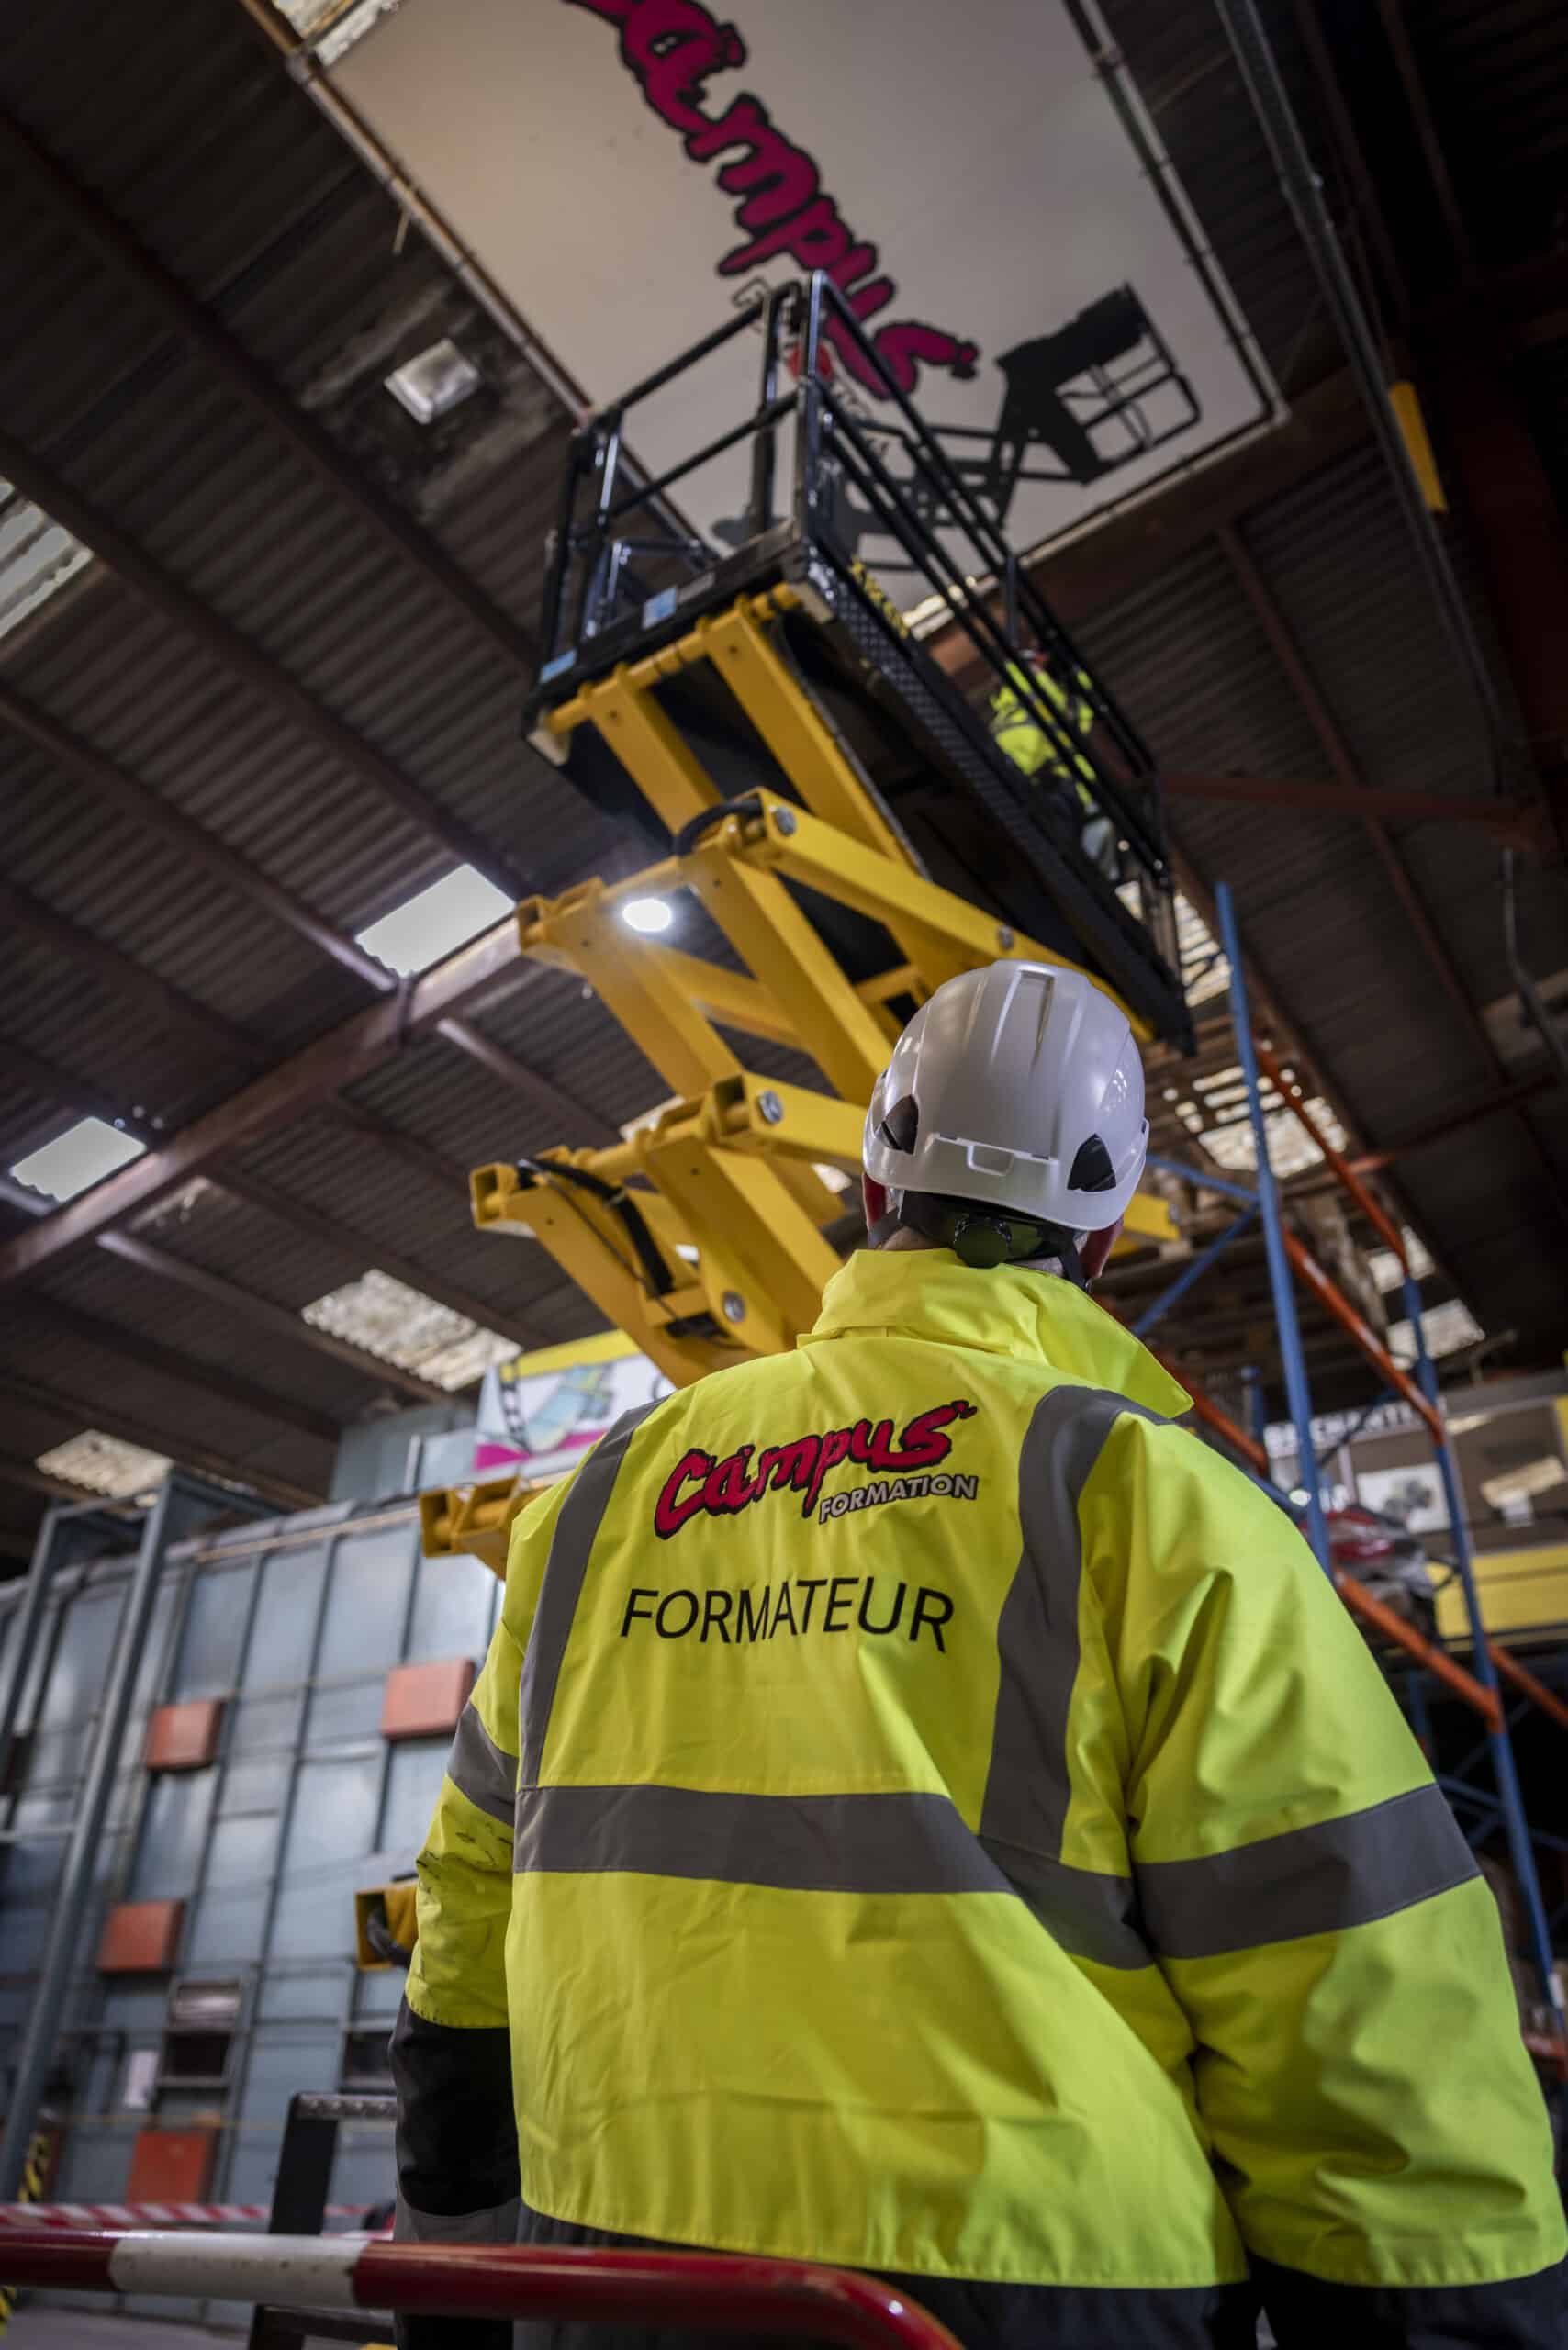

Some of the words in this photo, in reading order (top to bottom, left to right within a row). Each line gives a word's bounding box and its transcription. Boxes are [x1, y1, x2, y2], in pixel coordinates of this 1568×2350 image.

[562, 0, 980, 399] ampus
[655, 1400, 978, 1540] Campus
[819, 1474, 979, 1524] FORMATION
[621, 1576, 955, 1652] FORMATEUR
